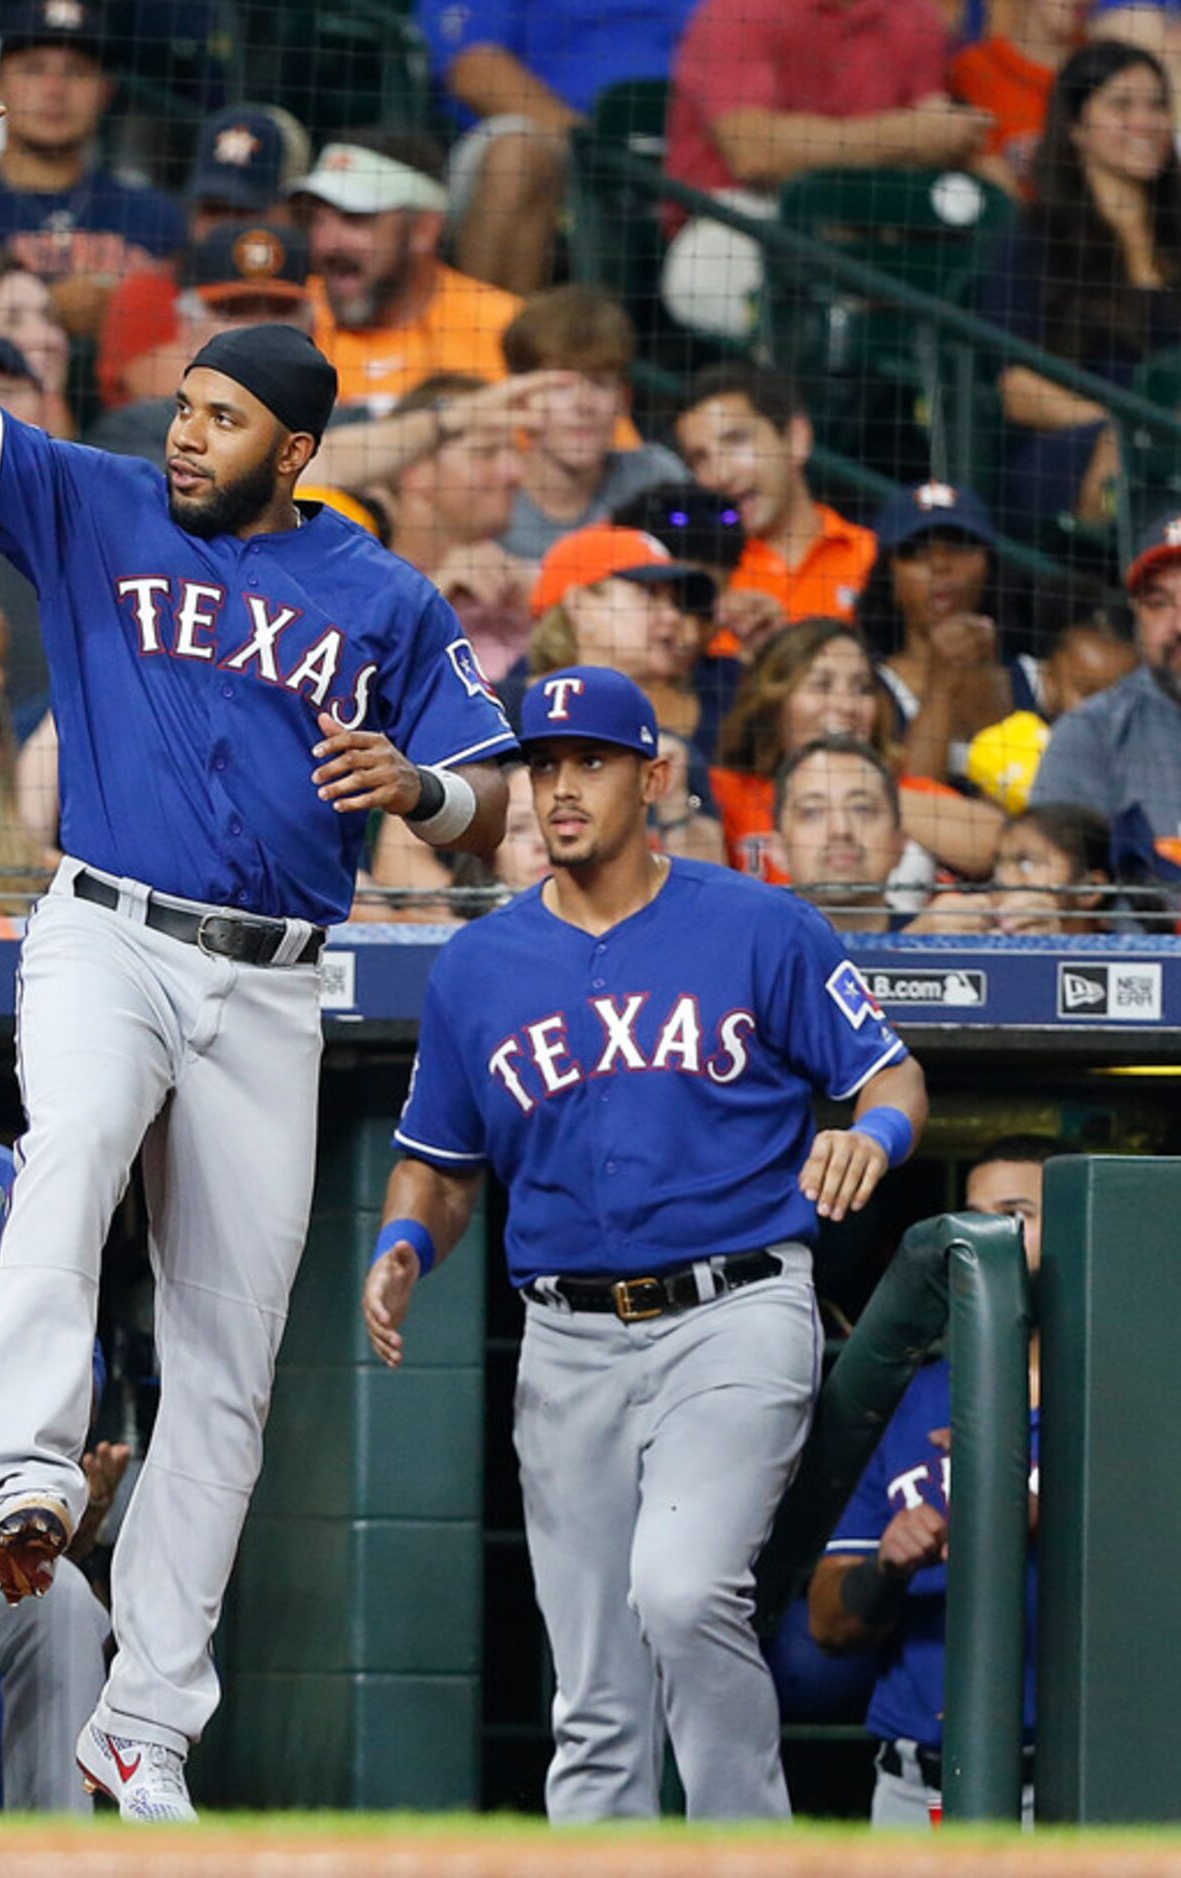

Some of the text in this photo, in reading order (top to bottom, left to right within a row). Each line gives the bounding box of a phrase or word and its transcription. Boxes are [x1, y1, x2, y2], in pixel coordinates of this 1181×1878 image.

[116, 576, 379, 731] TEXAS
[543, 677, 585, 721] T
[488, 991, 756, 1115] TEXAS
